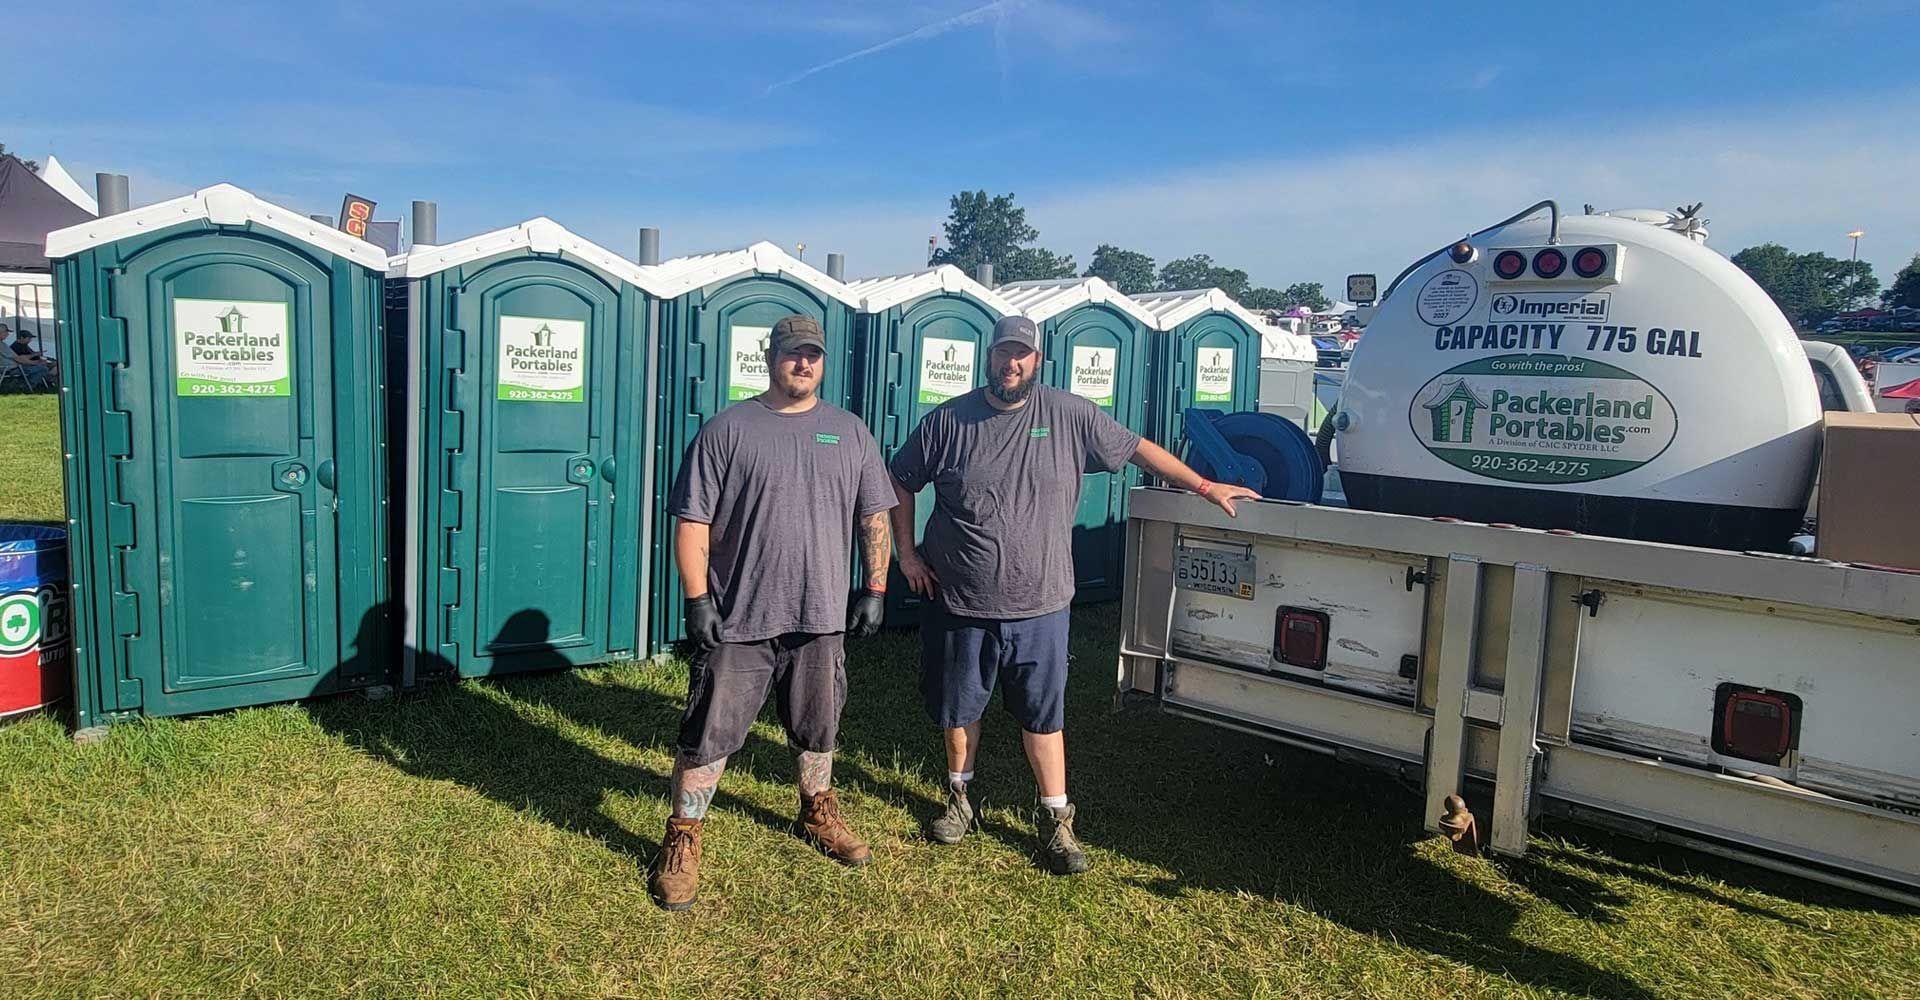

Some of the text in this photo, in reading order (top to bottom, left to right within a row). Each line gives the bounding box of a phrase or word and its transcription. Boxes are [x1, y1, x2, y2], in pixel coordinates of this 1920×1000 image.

[1519, 299, 1606, 318] Imperial
[184, 331, 281, 347] Packerland
[1435, 325, 1703, 358] CAPACITY 775 GAL
[191, 347, 275, 361] Portables
[506, 345, 578, 360] Packerland
[736, 351, 767, 362] Packe
[511, 358, 573, 372] Portables
[740, 363, 769, 374] Porta
[926, 360, 970, 372] Packerland
[1075, 366, 1112, 376] Packerland
[1491, 360, 1585, 373] Go with the pros!
[928, 370, 967, 382] Portables
[1077, 375, 1109, 385] Portables
[191, 384, 277, 394] 920-362-4275
[1491, 389, 1653, 420] Packerland
[1496, 439, 1527, 448] Division
[1528, 440, 1538, 448] of
[1562, 443, 1599, 451] SPYDER
[1600, 445, 1620, 453] LLC
[1471, 455, 1589, 476] 920-362-4275
[1190, 558, 1238, 585] 55133
[1193, 582, 1234, 593] WISCONSIN
